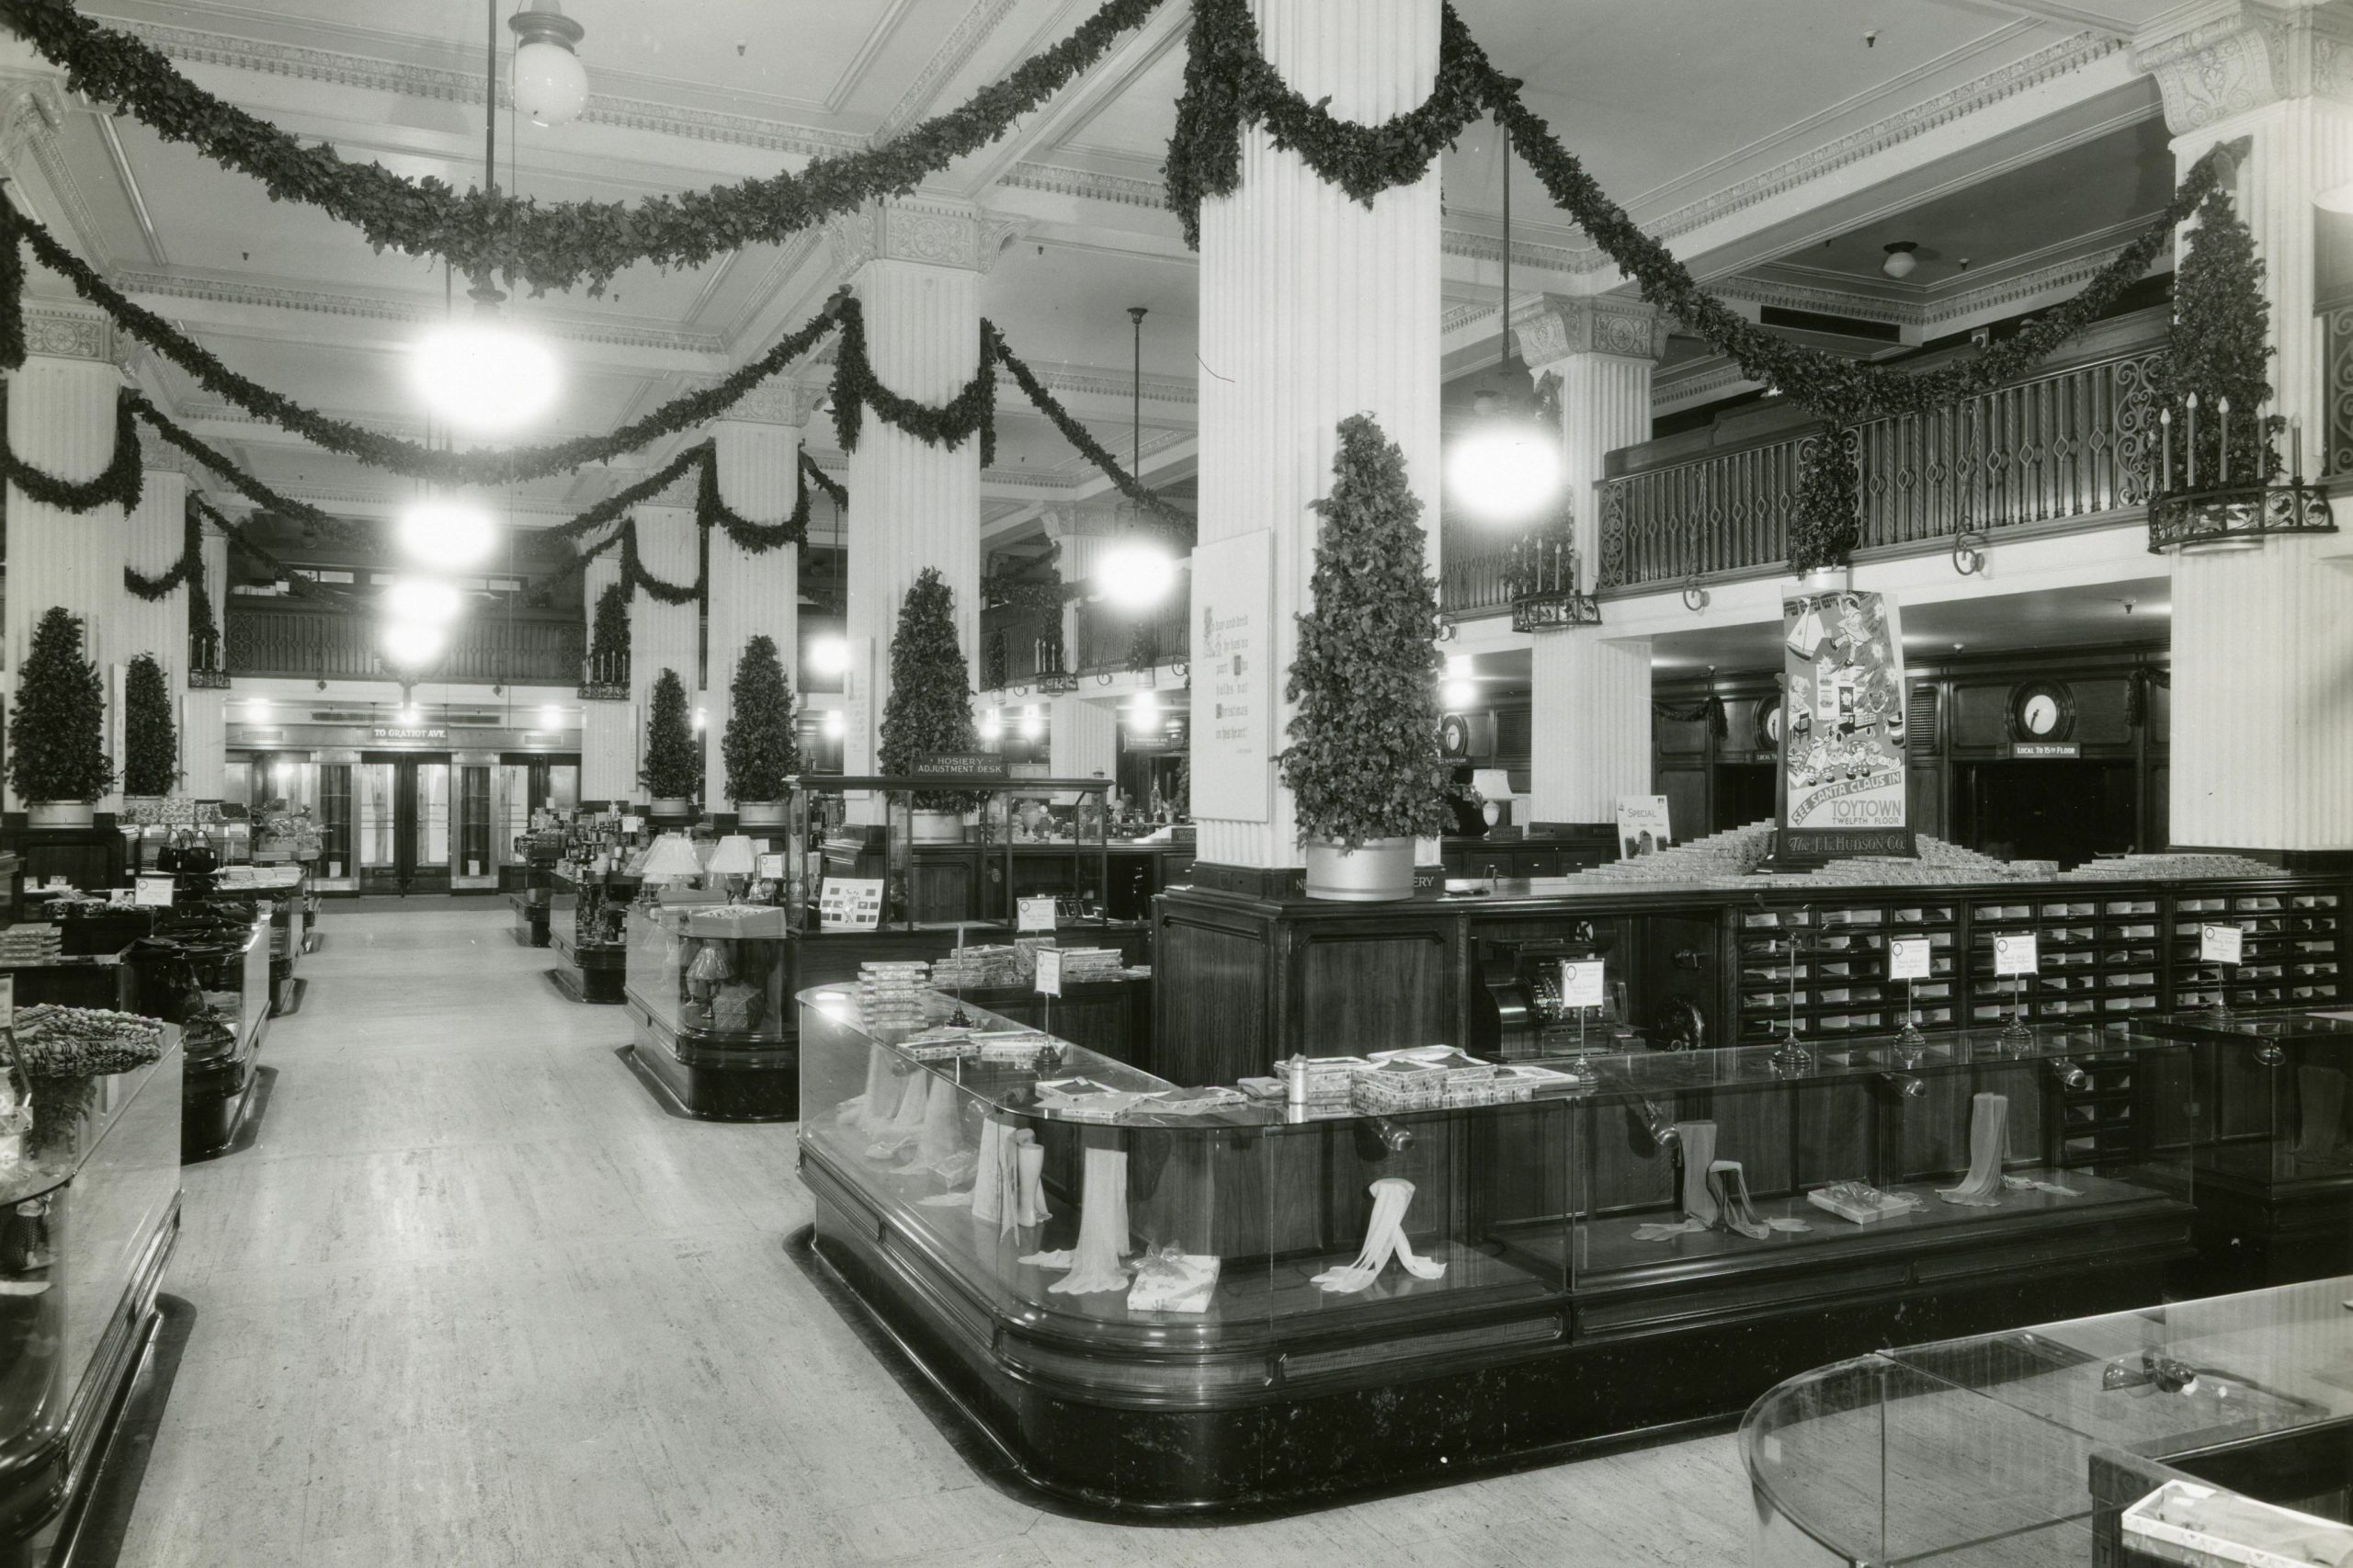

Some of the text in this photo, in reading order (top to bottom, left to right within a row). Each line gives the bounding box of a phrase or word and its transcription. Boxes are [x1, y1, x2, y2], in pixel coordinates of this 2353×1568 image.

[388, 729, 426, 738] GRATIOT
[427, 730, 447, 738] AVE.
[917, 765, 1002, 773] ADJUSTMENT DESK
[1792, 772, 1901, 825] SEE SANTA CLAUS IN
[1831, 800, 1901, 817] TOYTOWN
[1788, 836, 1810, 851] The
